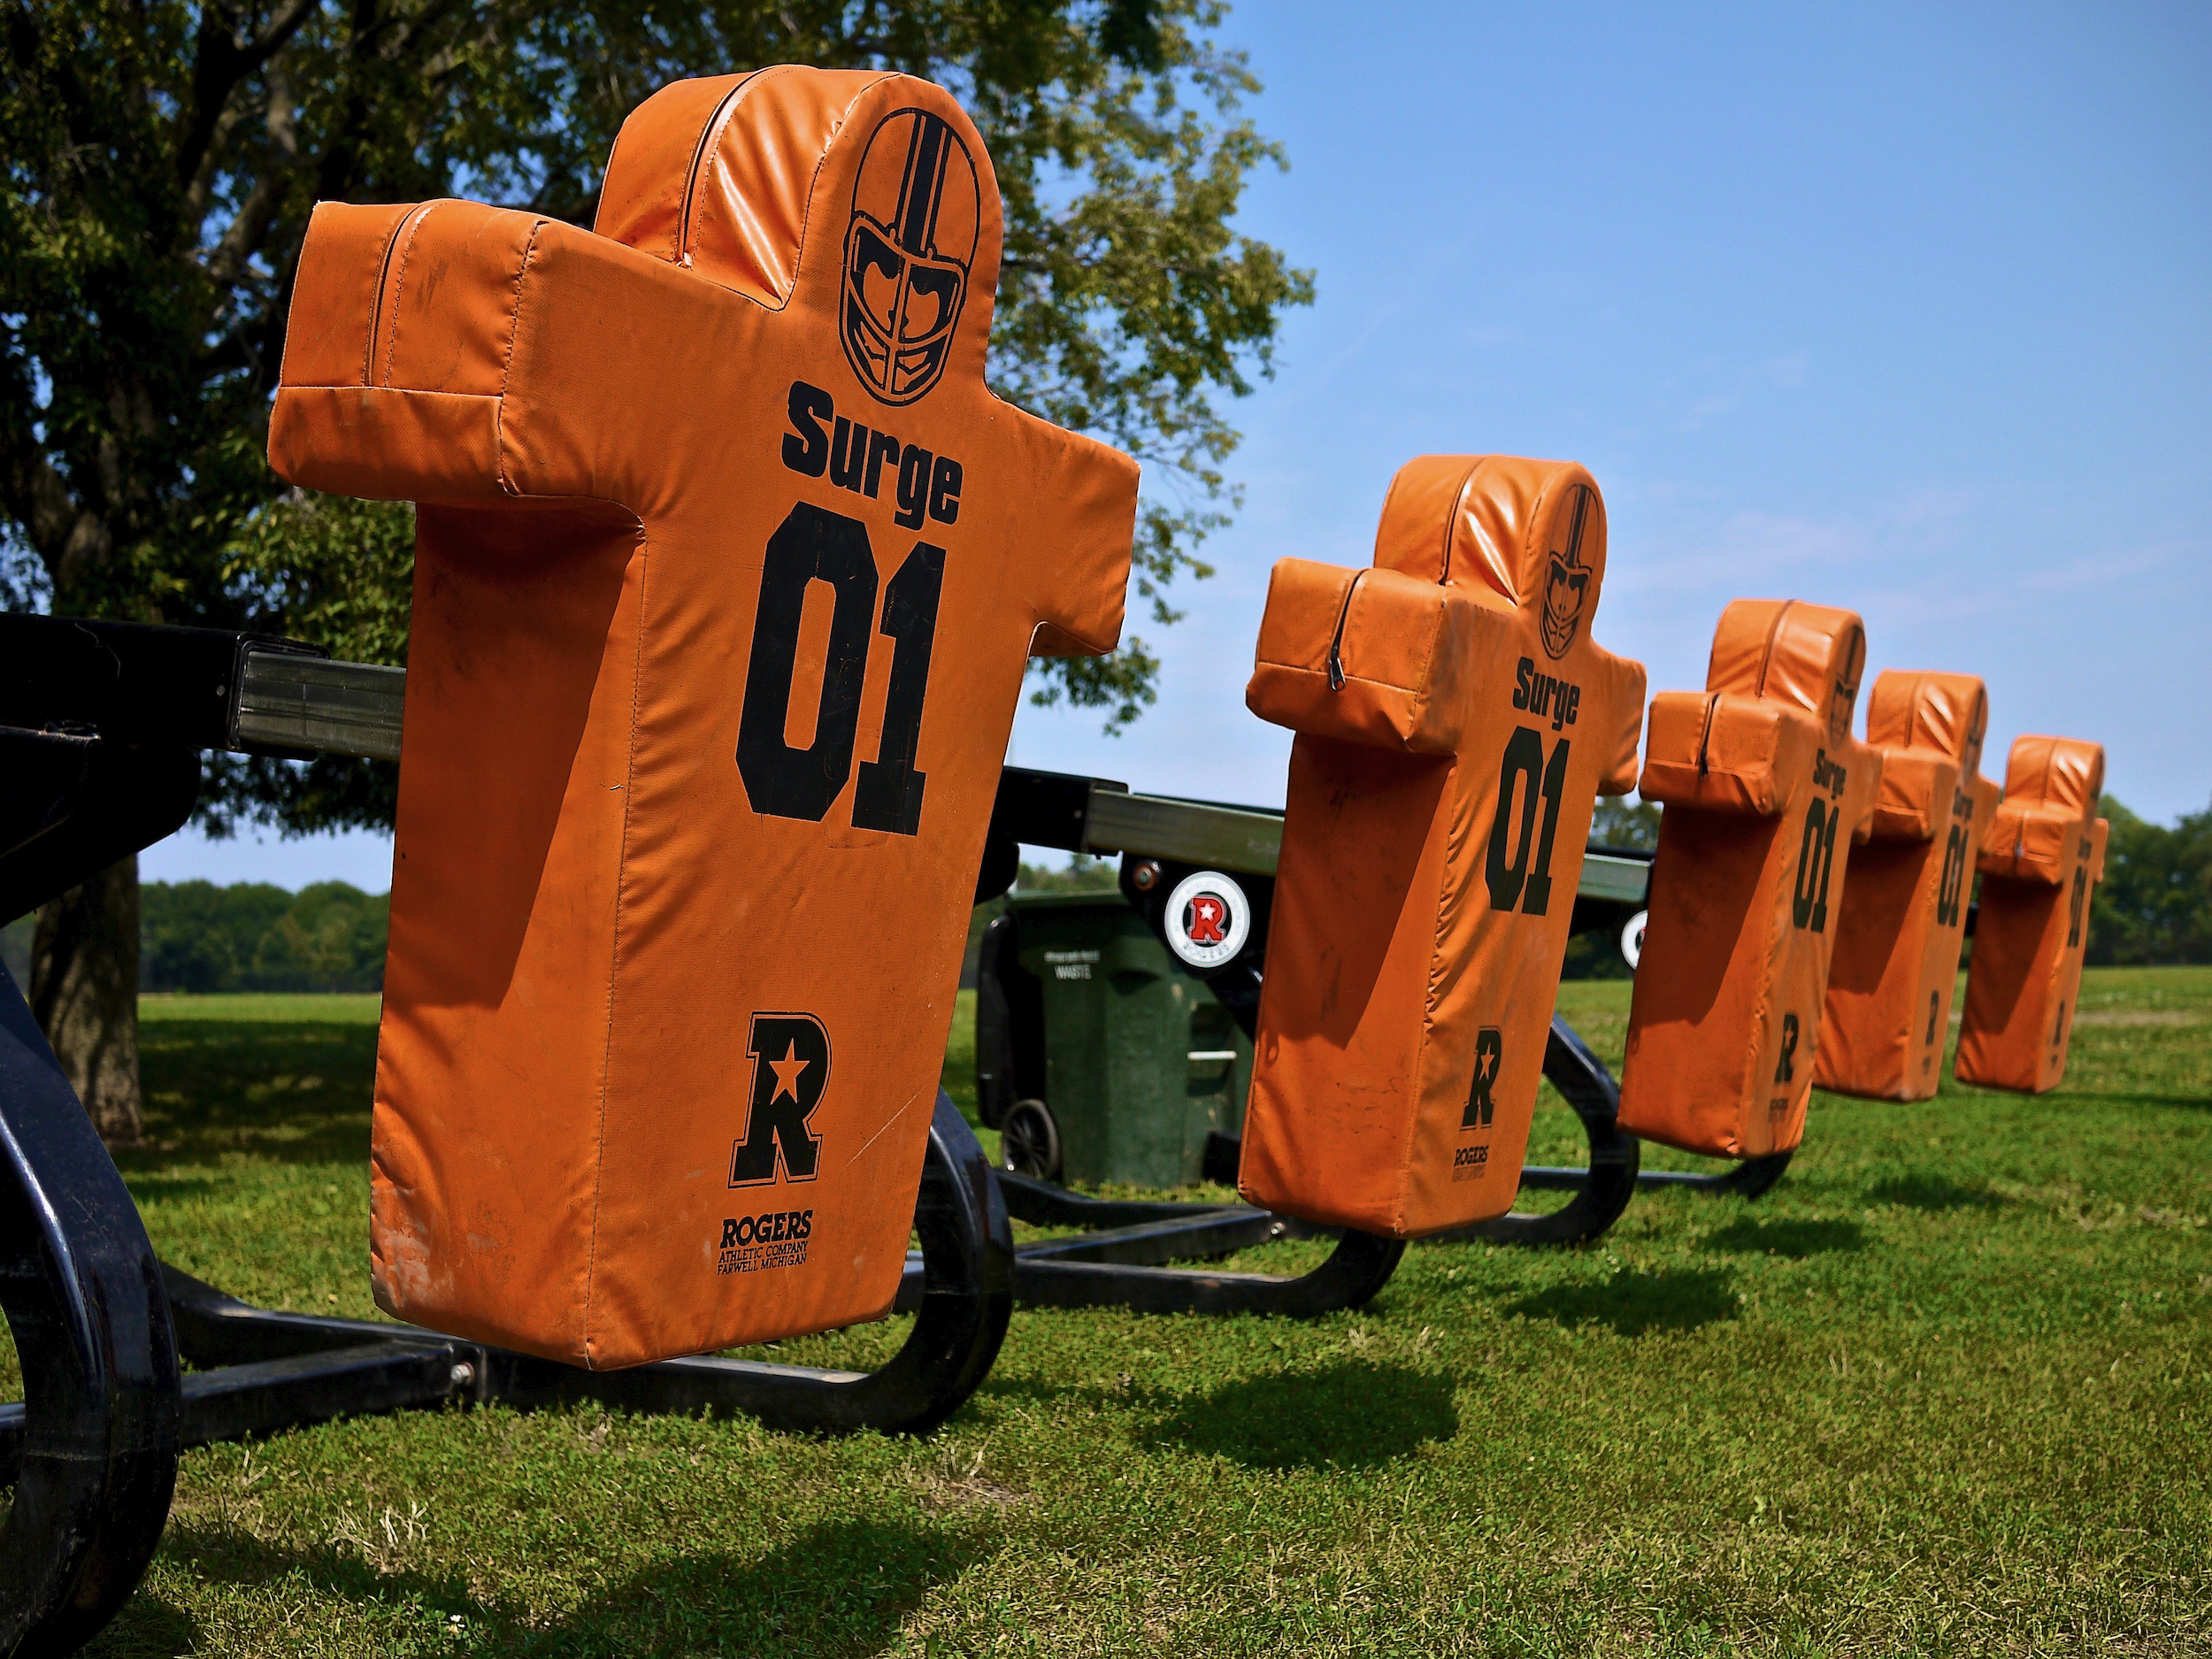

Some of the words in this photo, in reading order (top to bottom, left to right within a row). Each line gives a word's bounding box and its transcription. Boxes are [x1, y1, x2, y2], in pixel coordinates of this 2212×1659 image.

[781, 380, 963, 530] Surge
[735, 500, 947, 837] 01
[1512, 657, 1580, 732] Surge
[1485, 726, 1571, 917] 01
[1793, 797, 1839, 934] 01
[1188, 894, 1227, 944] R
[727, 1010, 833, 1189] R
[1459, 1025, 1502, 1132] R
[1453, 1144, 1489, 1167] ROGERS
[717, 1259, 758, 1276] FARWELL
[761, 1253, 807, 1271] MICHIGAN
[718, 1247, 764, 1263] ATHLETIC
[765, 1240, 809, 1257] COMPANY
[719, 1210, 813, 1249] ROGERS
